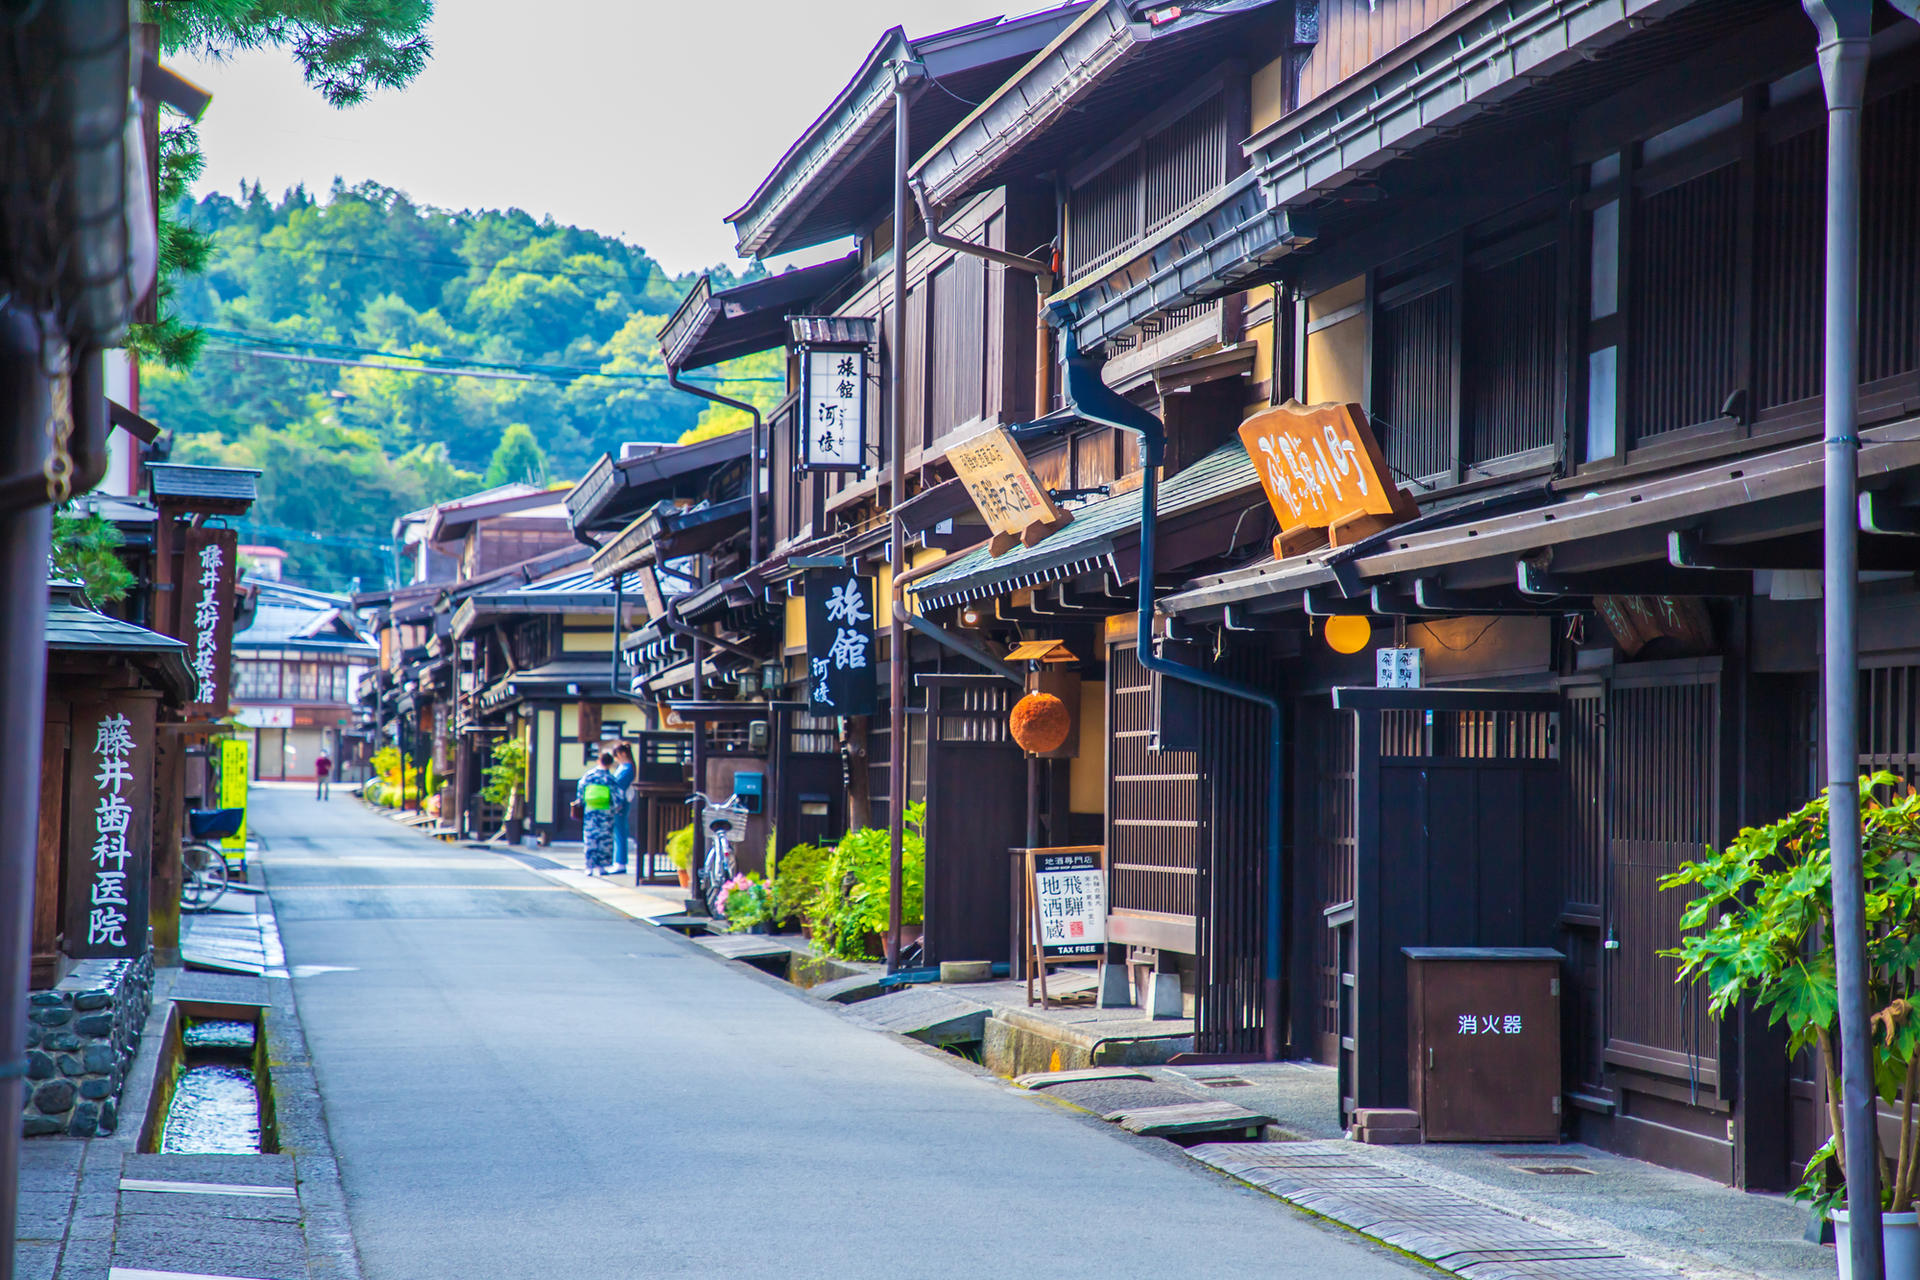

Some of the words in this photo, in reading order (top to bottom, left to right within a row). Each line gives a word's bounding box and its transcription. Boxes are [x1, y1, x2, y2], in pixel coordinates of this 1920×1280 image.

[836, 356, 857, 399] 旅館
[825, 577, 872, 671] 旅館
[88, 712, 137, 947] 藤井歯科医院
[1041, 875, 1065, 939] 地酒蔵
[1062, 875, 1085, 917] 飛騨
[1058, 946, 1074, 954] TAX
[1075, 945, 1096, 953] FREE
[1458, 1014, 1522, 1035] 消火器
